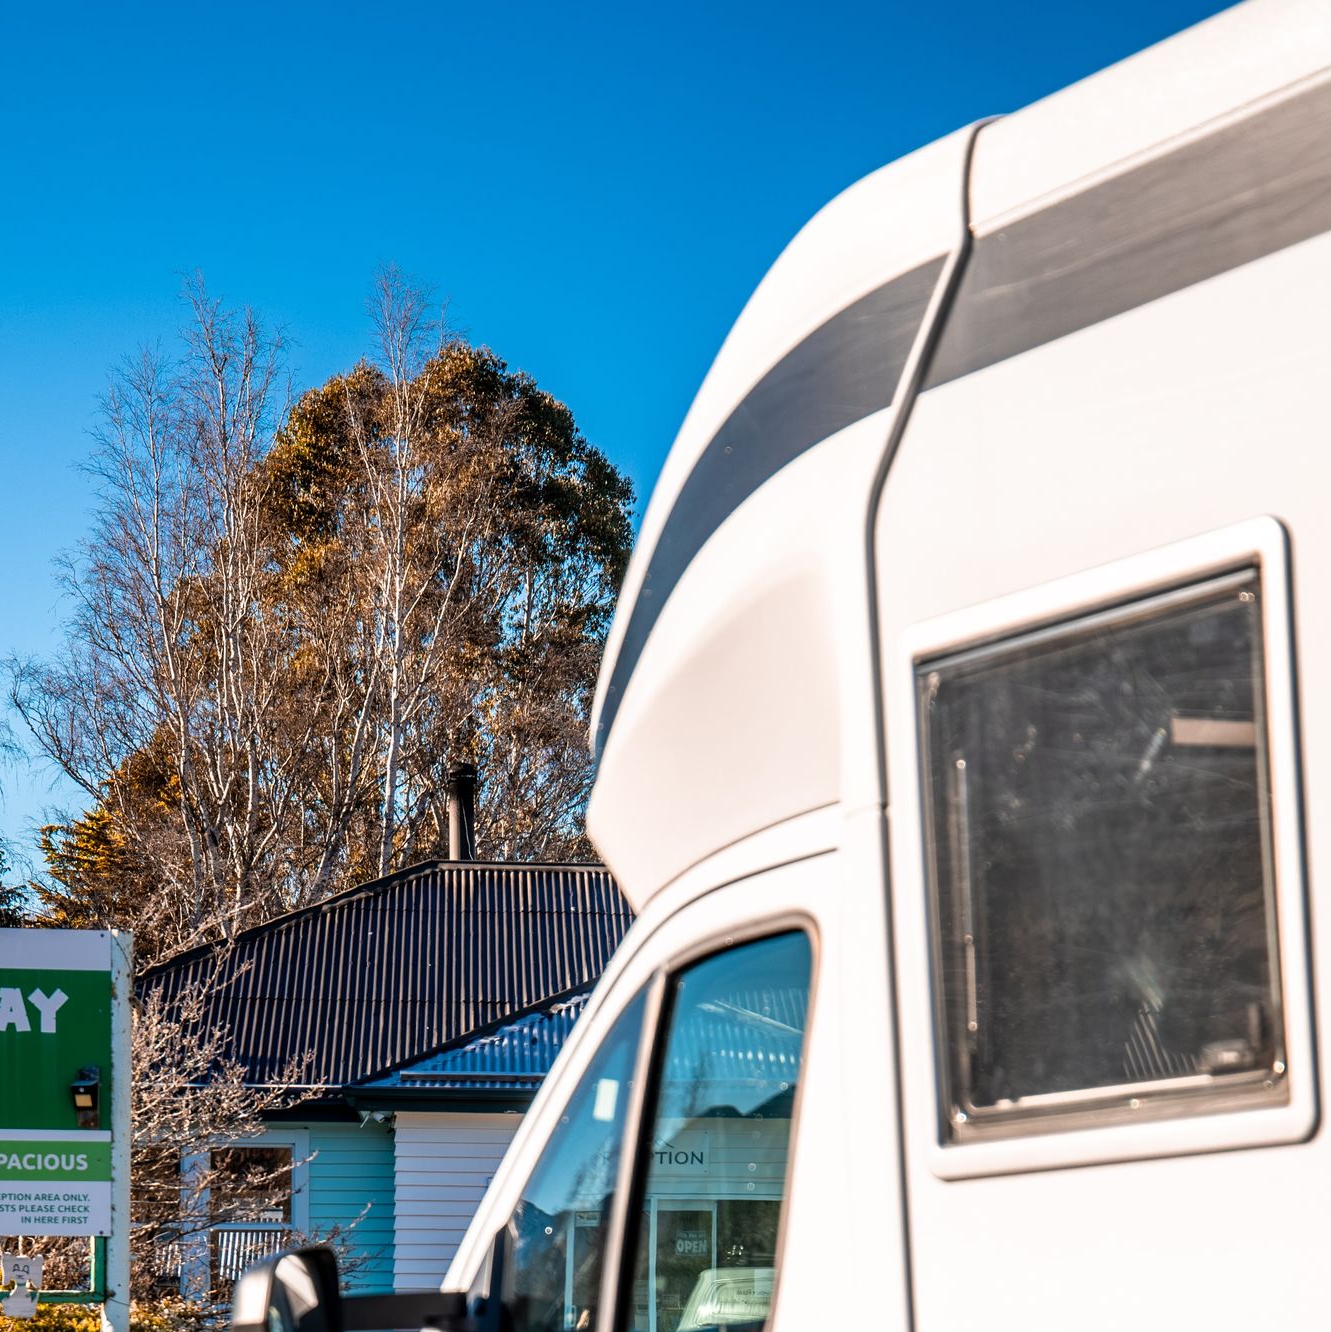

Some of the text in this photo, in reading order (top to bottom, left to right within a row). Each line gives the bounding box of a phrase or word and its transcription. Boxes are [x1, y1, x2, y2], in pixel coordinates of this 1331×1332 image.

[651, 1151, 704, 1165] TION
[34, 1194, 61, 1202] AREA
[62, 1194, 91, 1202] ONLY.
[18, 1204, 55, 1213] PLEASE
[57, 1205, 90, 1213] CHECK
[21, 1216, 88, 1224] IN HERE FIRST
[676, 1238, 707, 1253] OPEN
